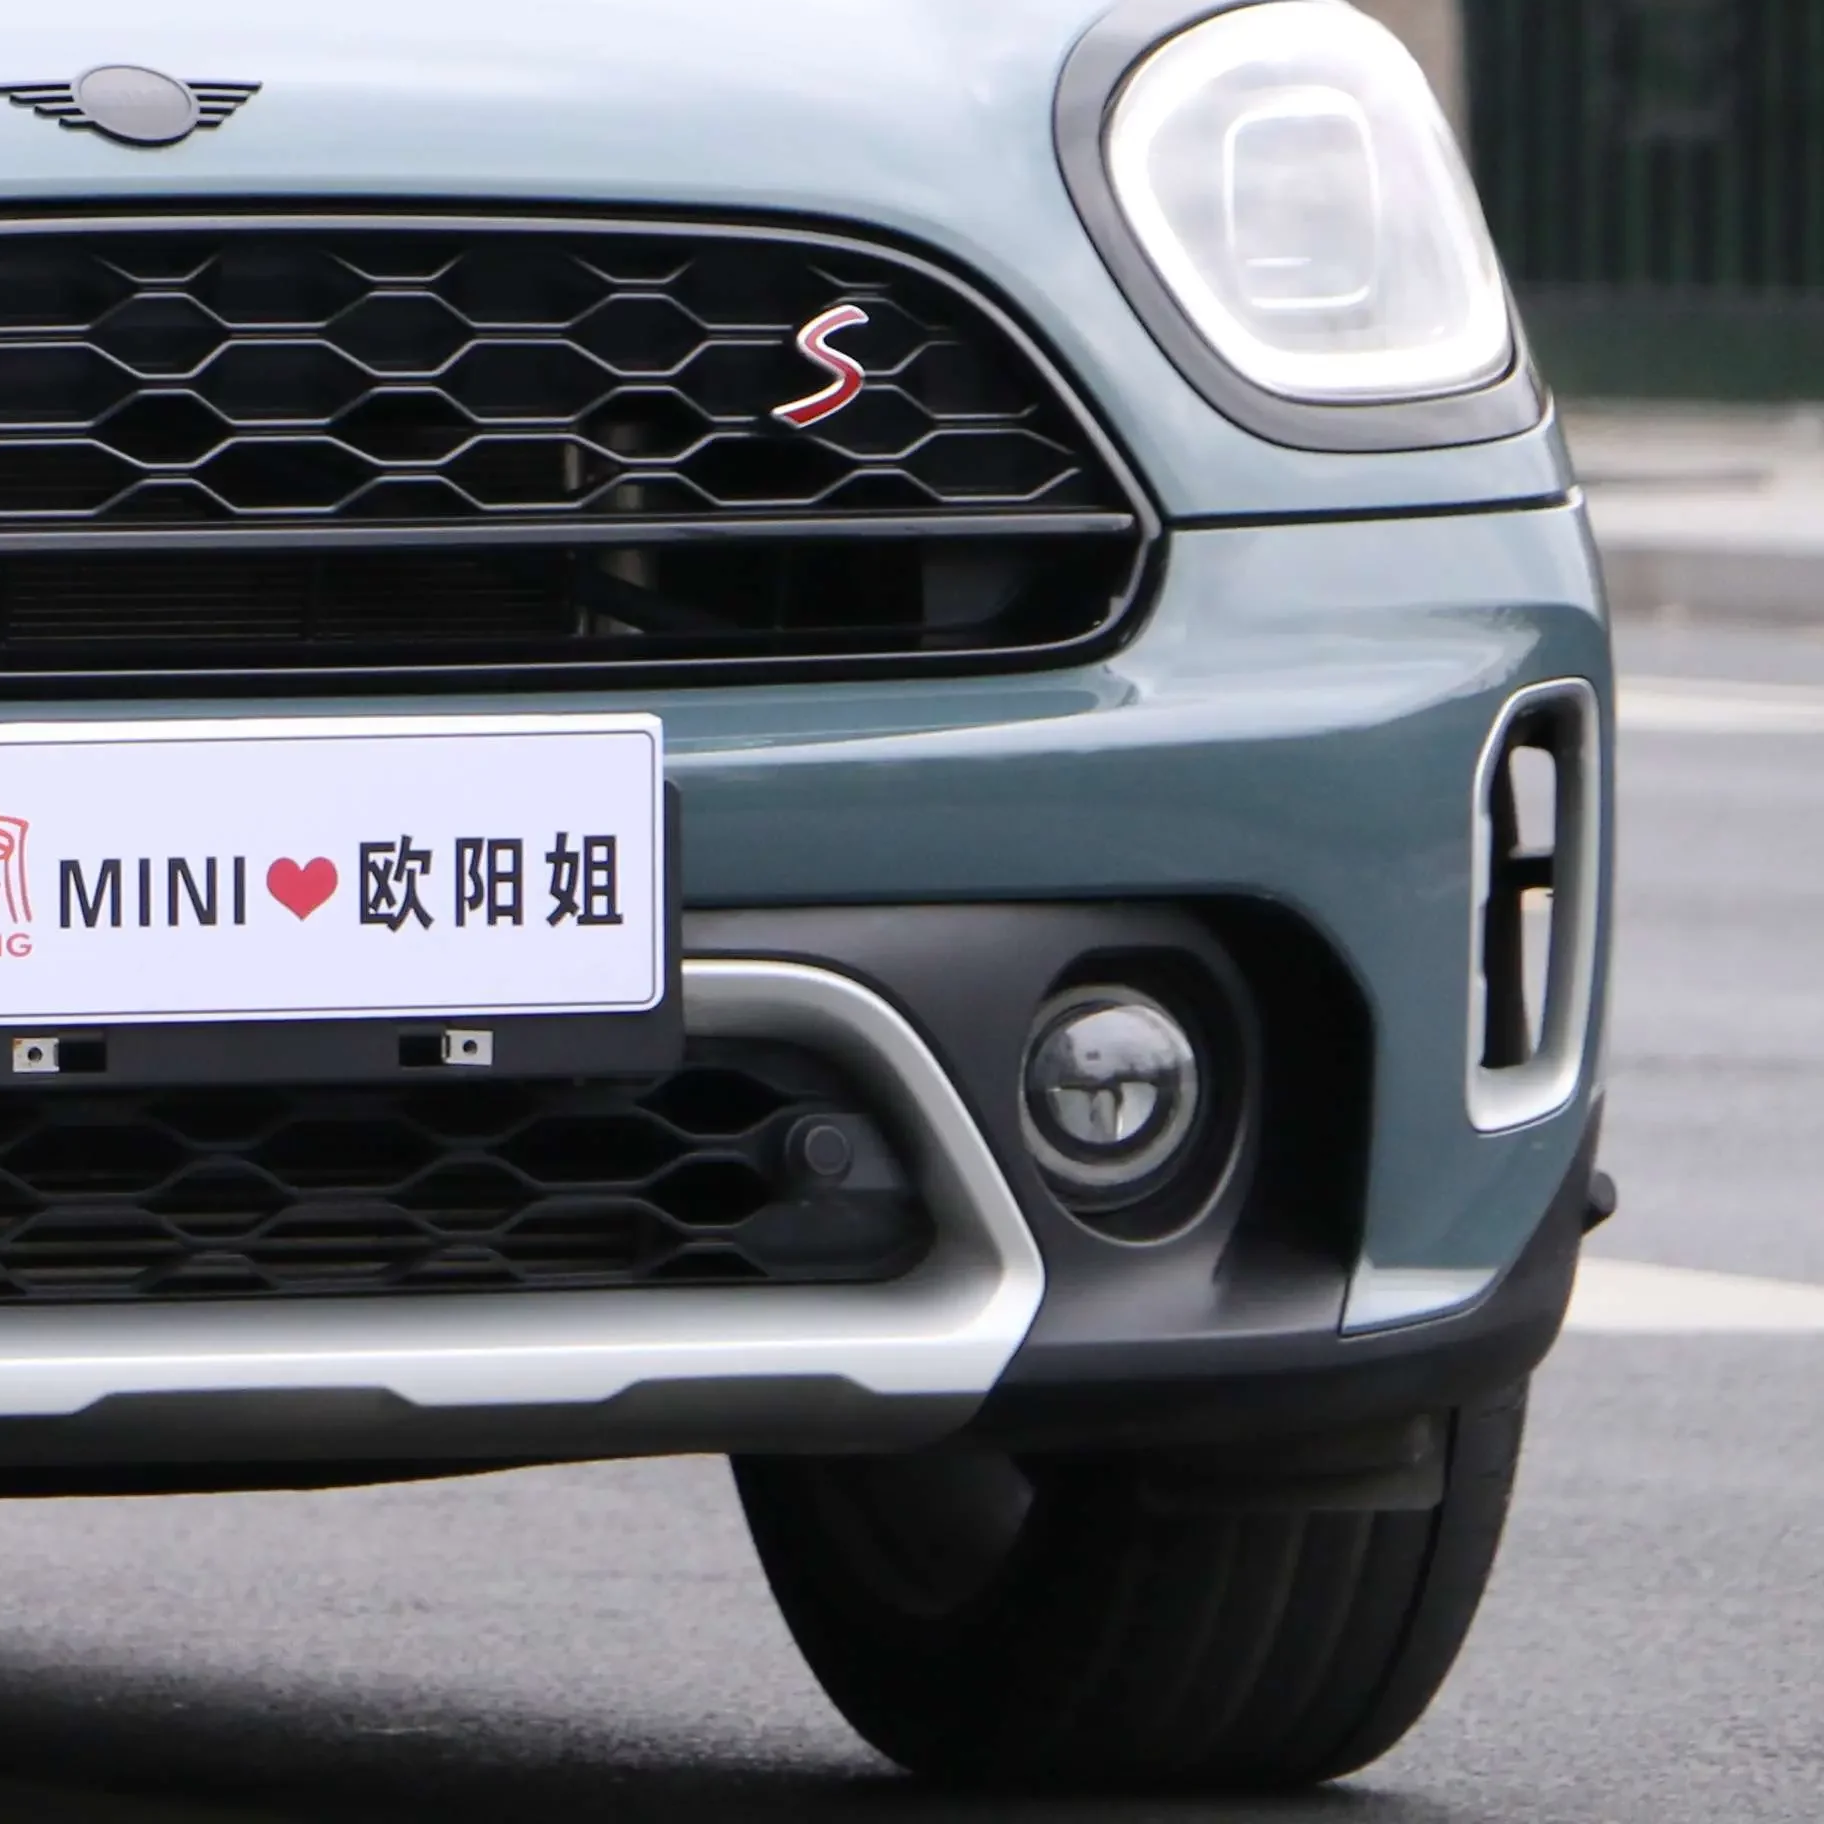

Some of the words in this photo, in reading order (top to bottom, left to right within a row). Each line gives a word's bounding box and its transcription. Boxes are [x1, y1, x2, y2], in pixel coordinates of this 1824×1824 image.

[770, 303, 870, 429] S
[58, 856, 247, 930] MINI
[358, 832, 624, 932] 欧阳姐
